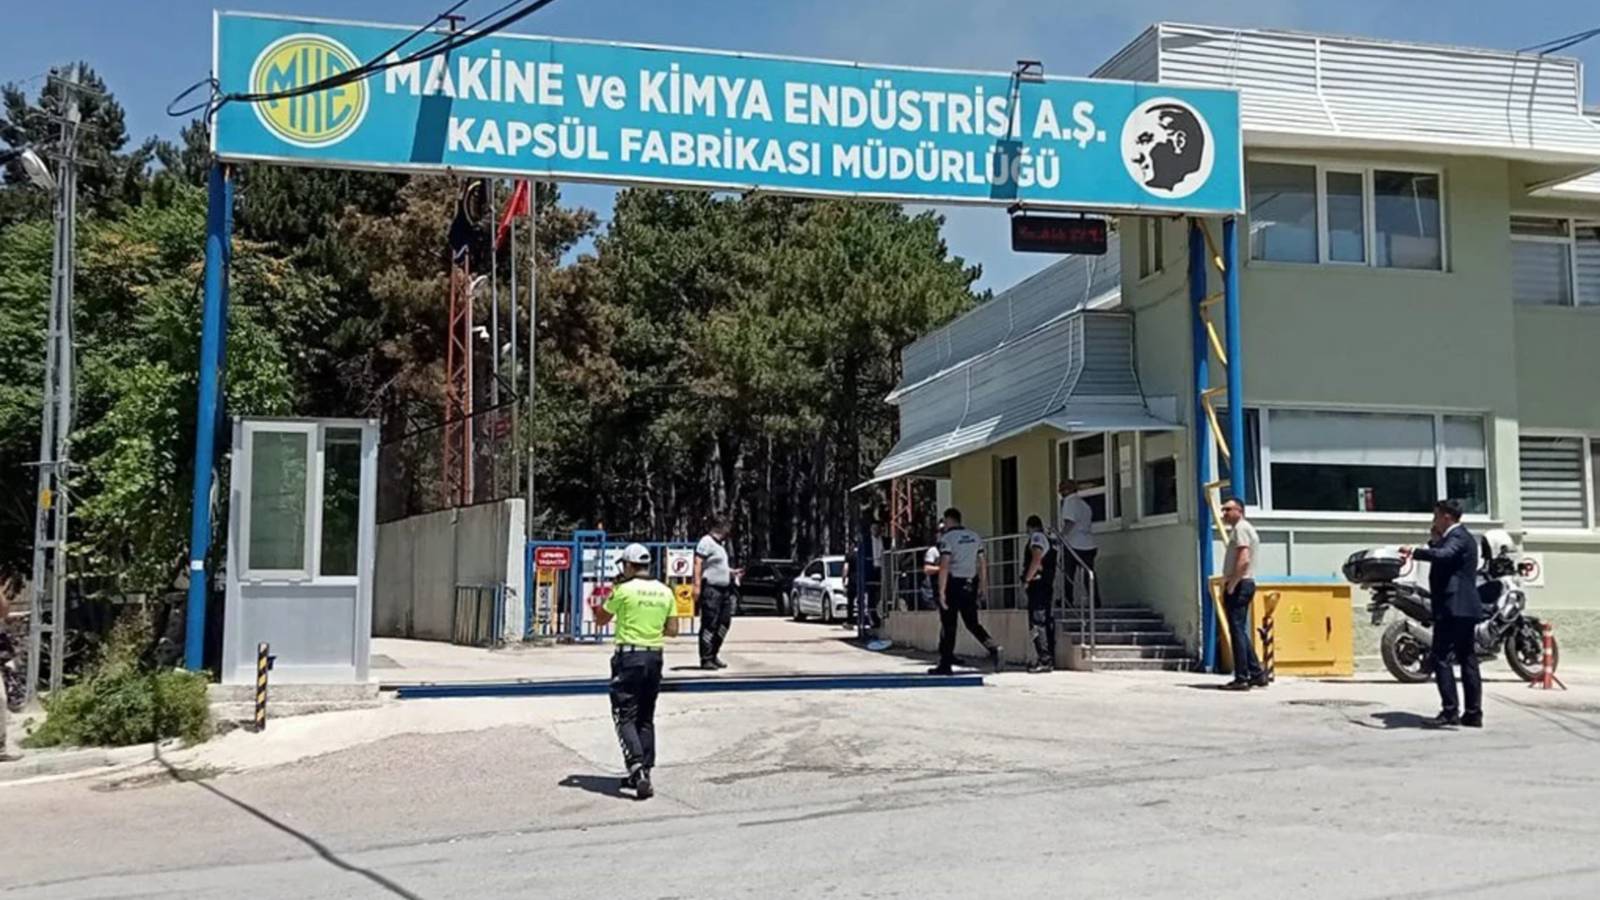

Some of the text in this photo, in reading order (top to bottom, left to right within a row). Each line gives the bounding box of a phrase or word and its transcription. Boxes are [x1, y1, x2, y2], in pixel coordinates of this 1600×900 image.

[384, 48, 1106, 149] MAKİNE ve KİMYA ENDÜSTRİSİ A.Ş.
[448, 116, 1060, 188] KAPSÜL FABRİKASI MÜDÜRLÜĞÜ
